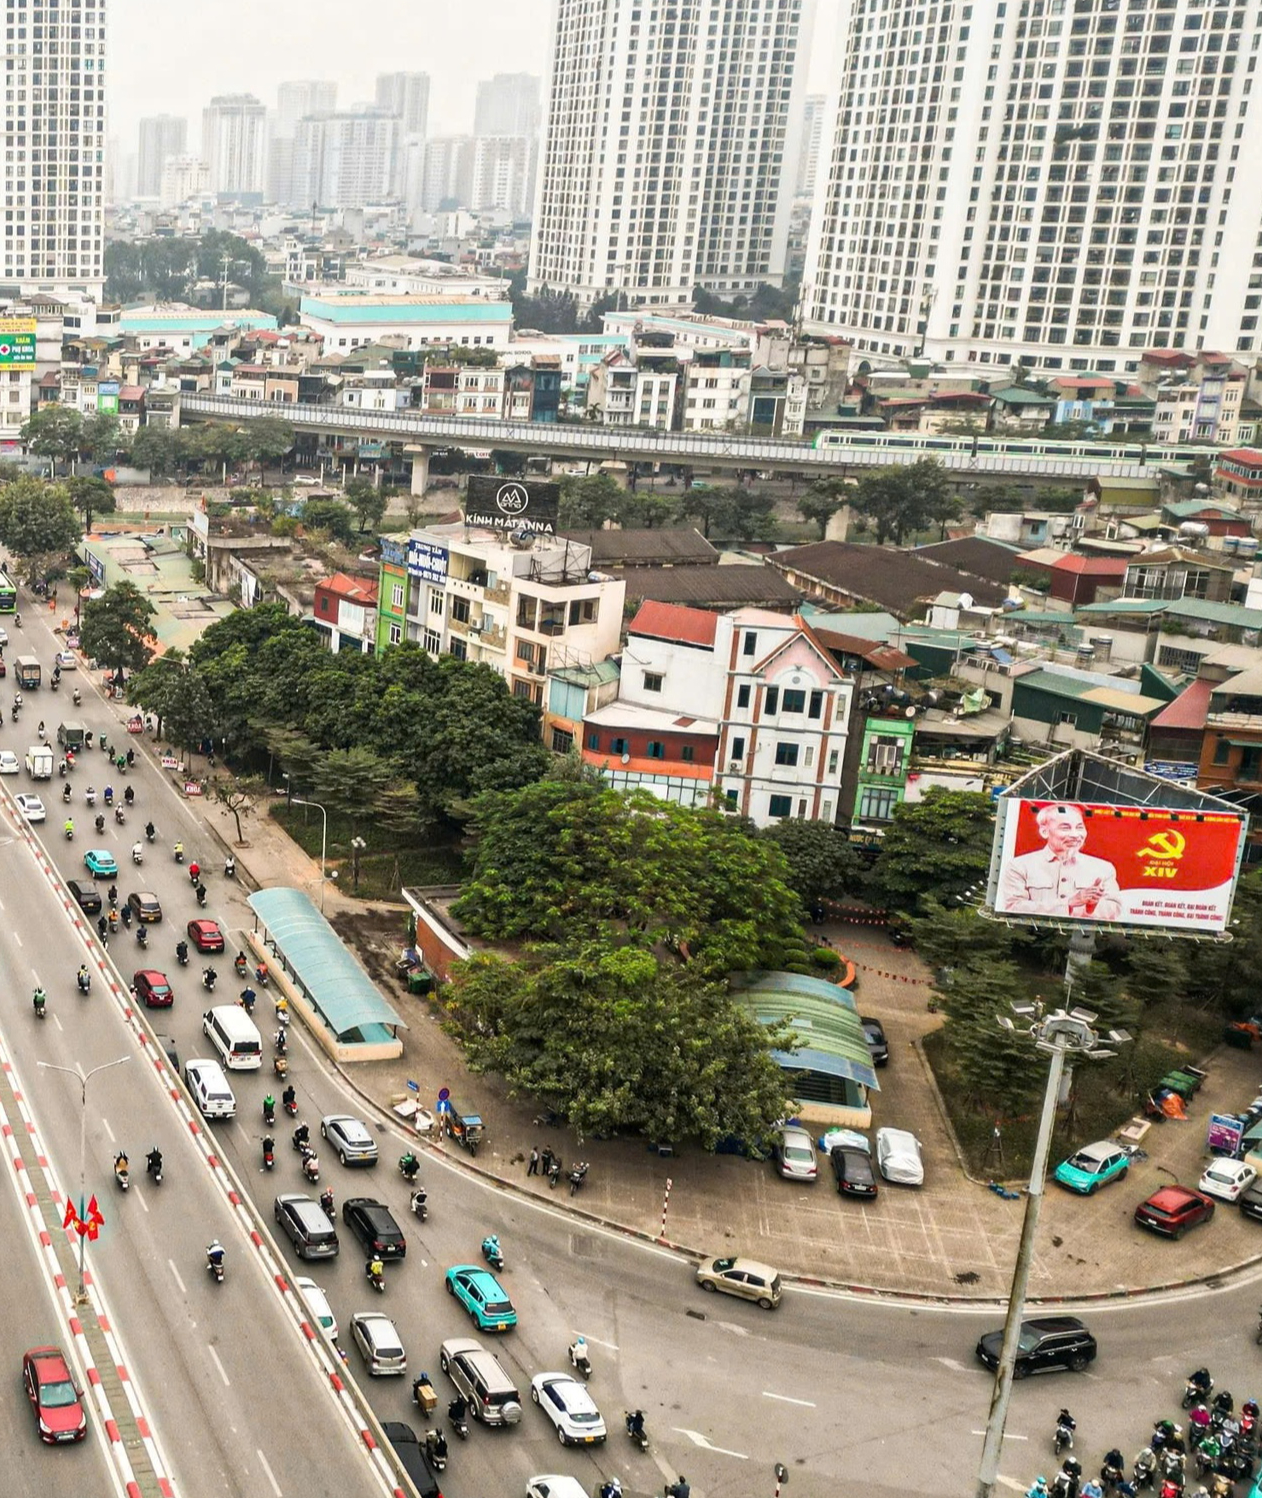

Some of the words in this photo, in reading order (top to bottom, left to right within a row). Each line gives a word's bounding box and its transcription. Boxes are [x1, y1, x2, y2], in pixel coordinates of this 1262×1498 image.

[466, 513, 492, 526] KÍNH
[518, 519, 553, 533] ANNA
[1142, 866, 1179, 878] XIV
